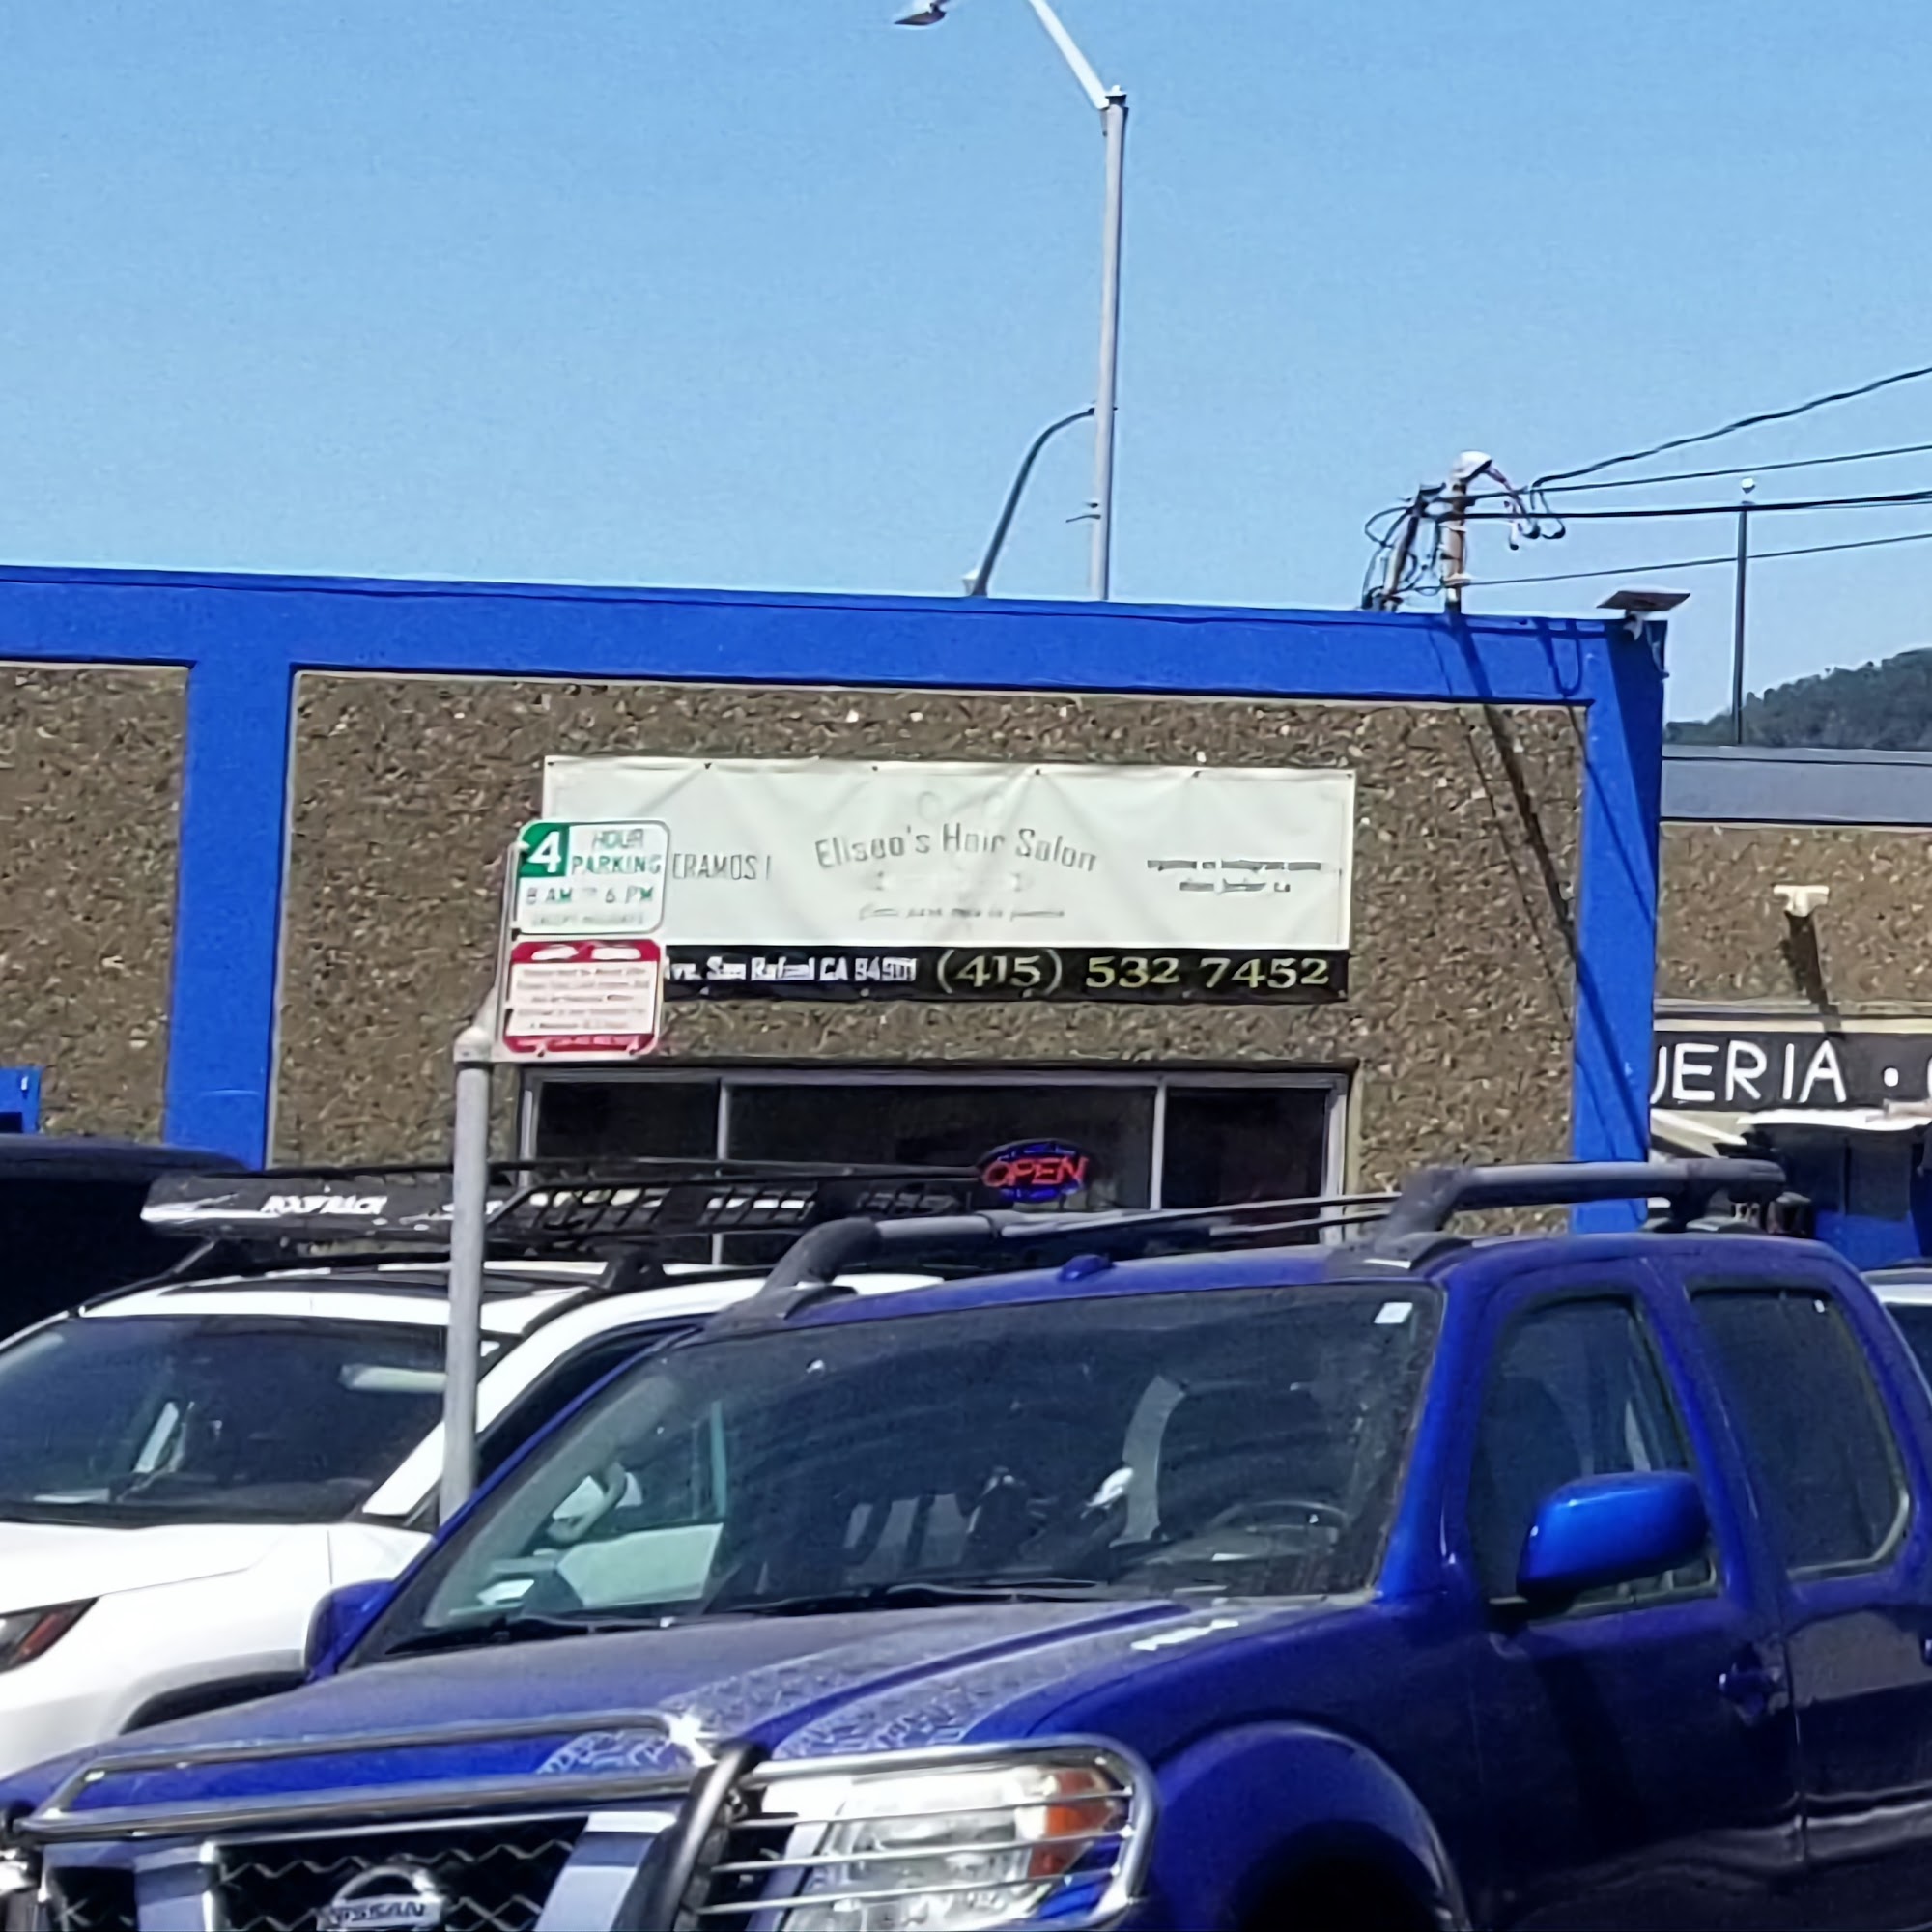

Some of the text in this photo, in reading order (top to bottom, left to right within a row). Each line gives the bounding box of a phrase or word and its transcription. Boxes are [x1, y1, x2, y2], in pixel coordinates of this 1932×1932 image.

[526, 830, 562, 873] 4
[571, 855, 662, 874] PARKING
[943, 822, 1004, 853] Hair
[1016, 828, 1097, 872] Salon
[546, 887, 573, 904] AM
[605, 887, 616, 904] 6
[626, 886, 654, 904] PM
[937, 948, 1063, 994] (415)
[1085, 955, 1180, 989] 532
[1200, 957, 1330, 990] 7452
[982, 1156, 1089, 1187] OPEN
